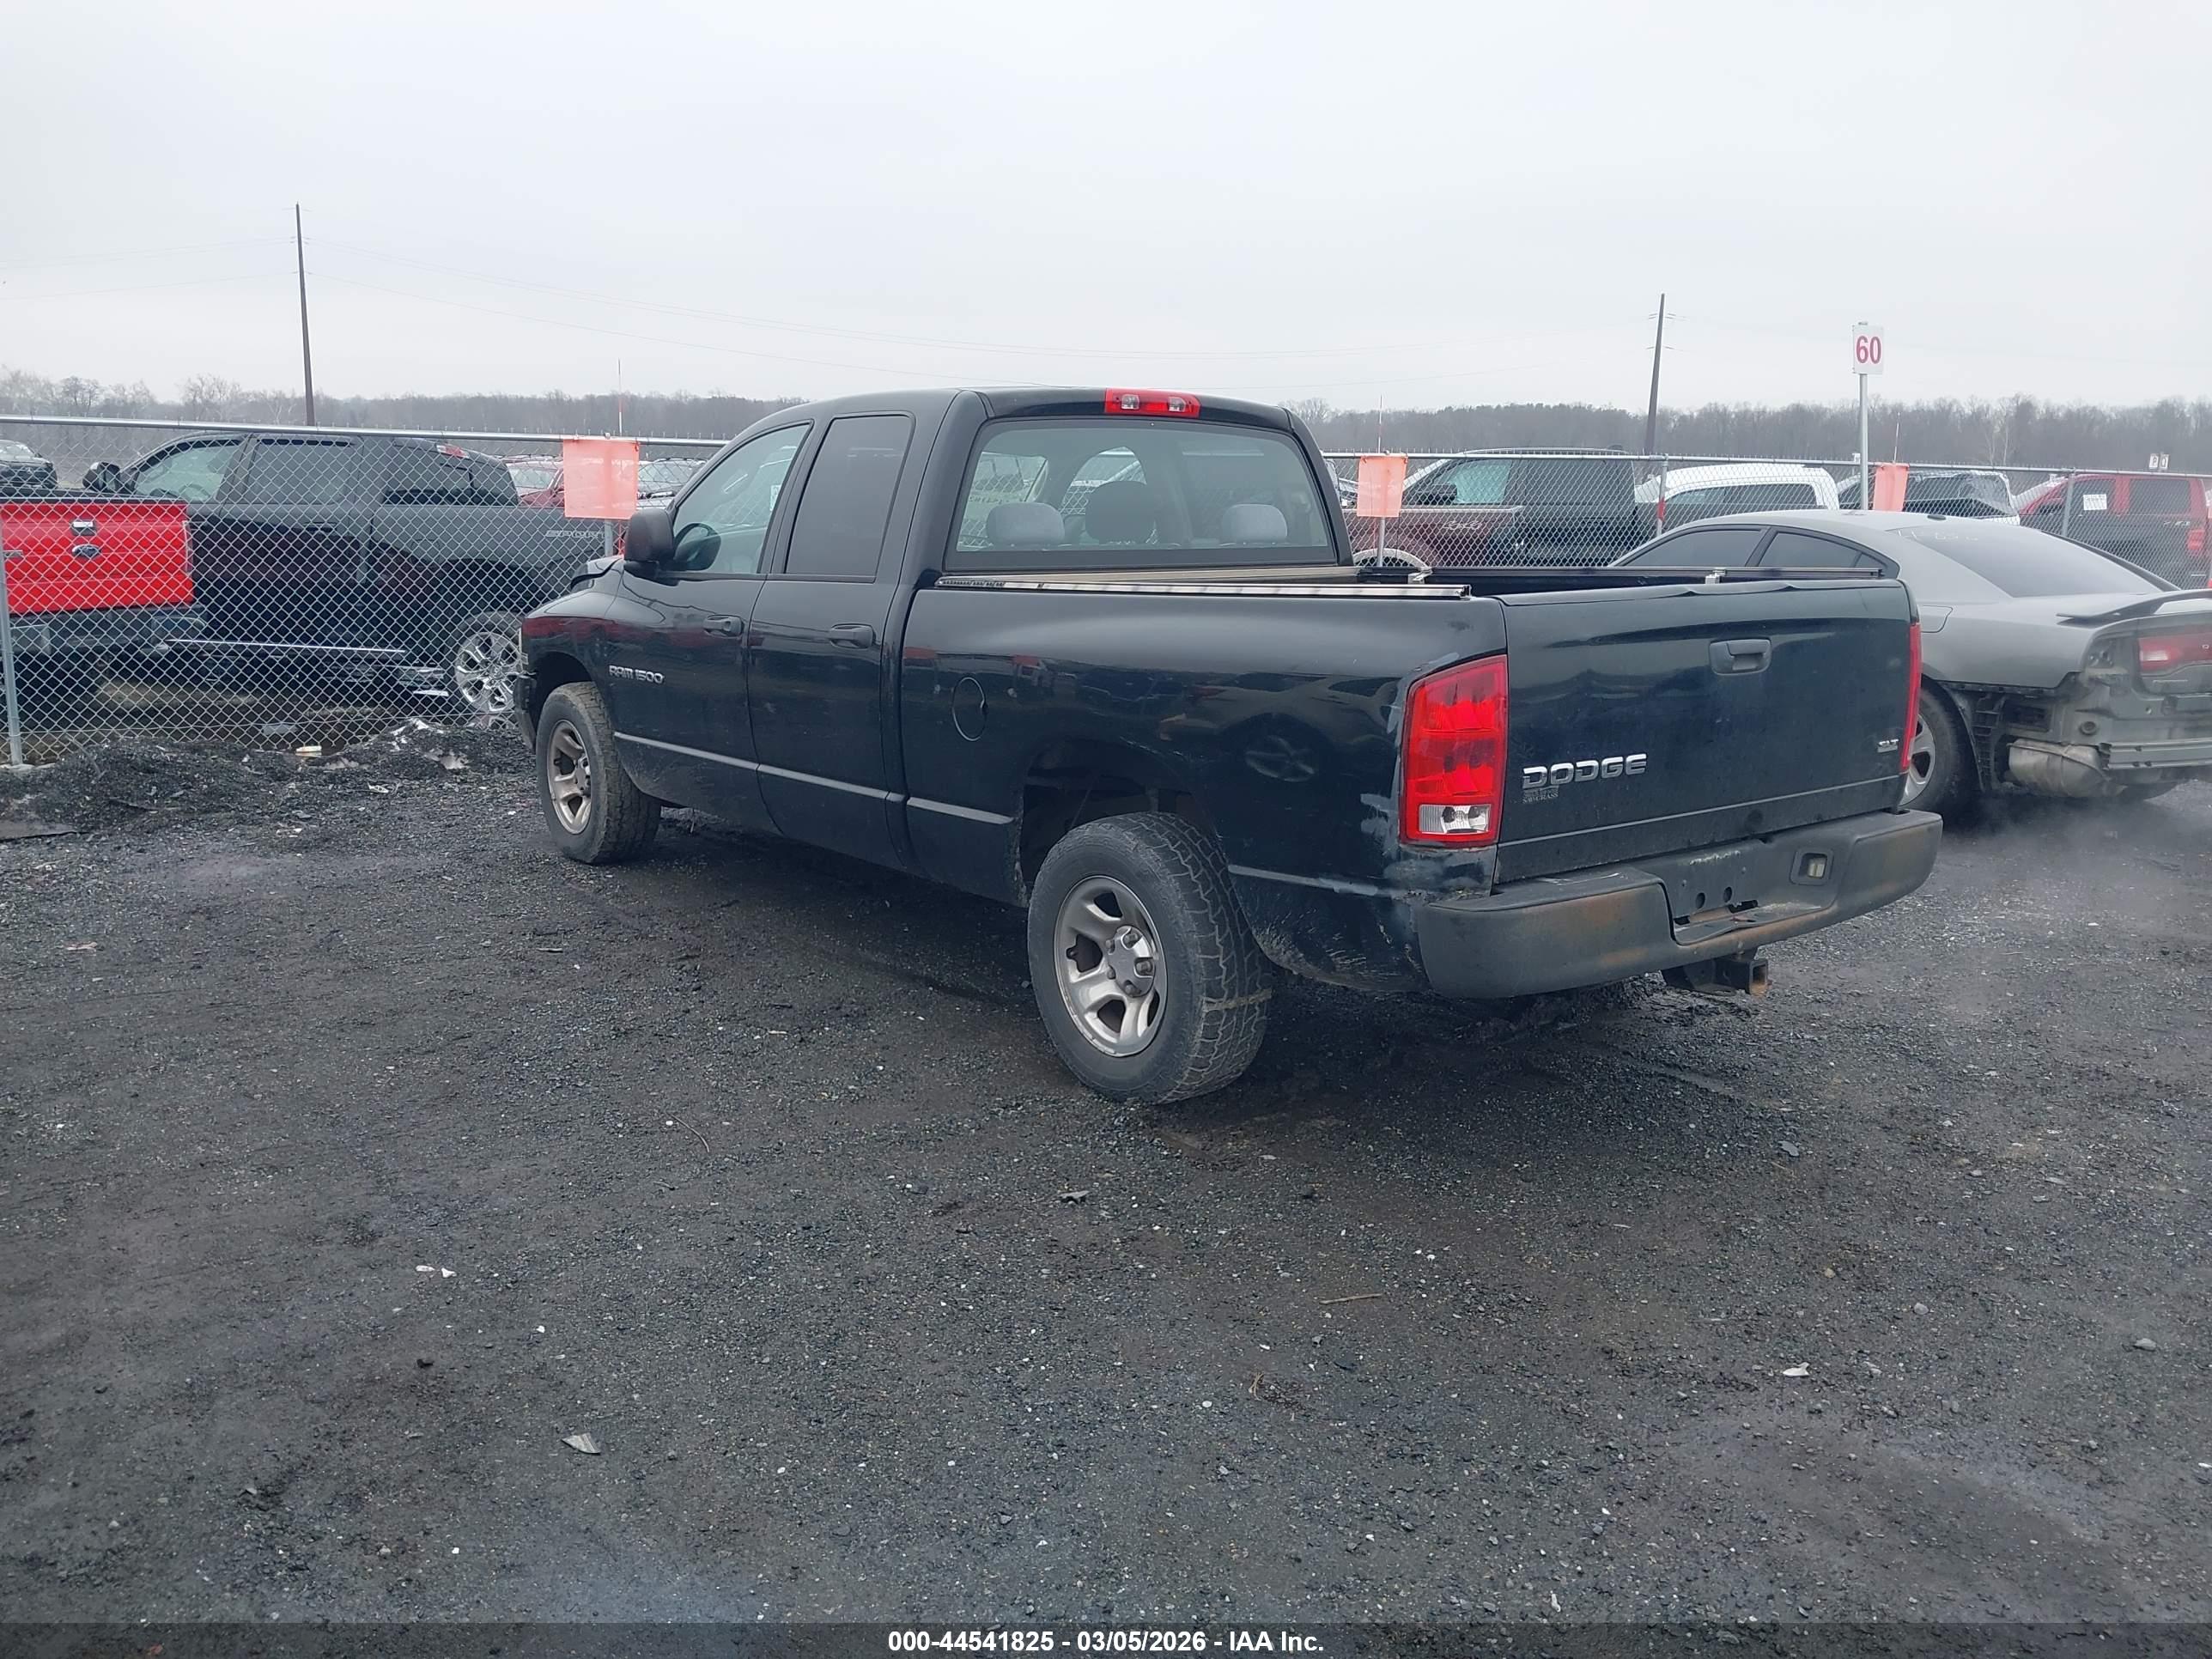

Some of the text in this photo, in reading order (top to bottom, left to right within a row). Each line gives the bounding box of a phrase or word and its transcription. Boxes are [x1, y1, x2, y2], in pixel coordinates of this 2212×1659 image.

[1856, 335, 1882, 365] 60
[608, 665, 665, 684] RAM 1500
[1522, 753, 1647, 789] DODGE
